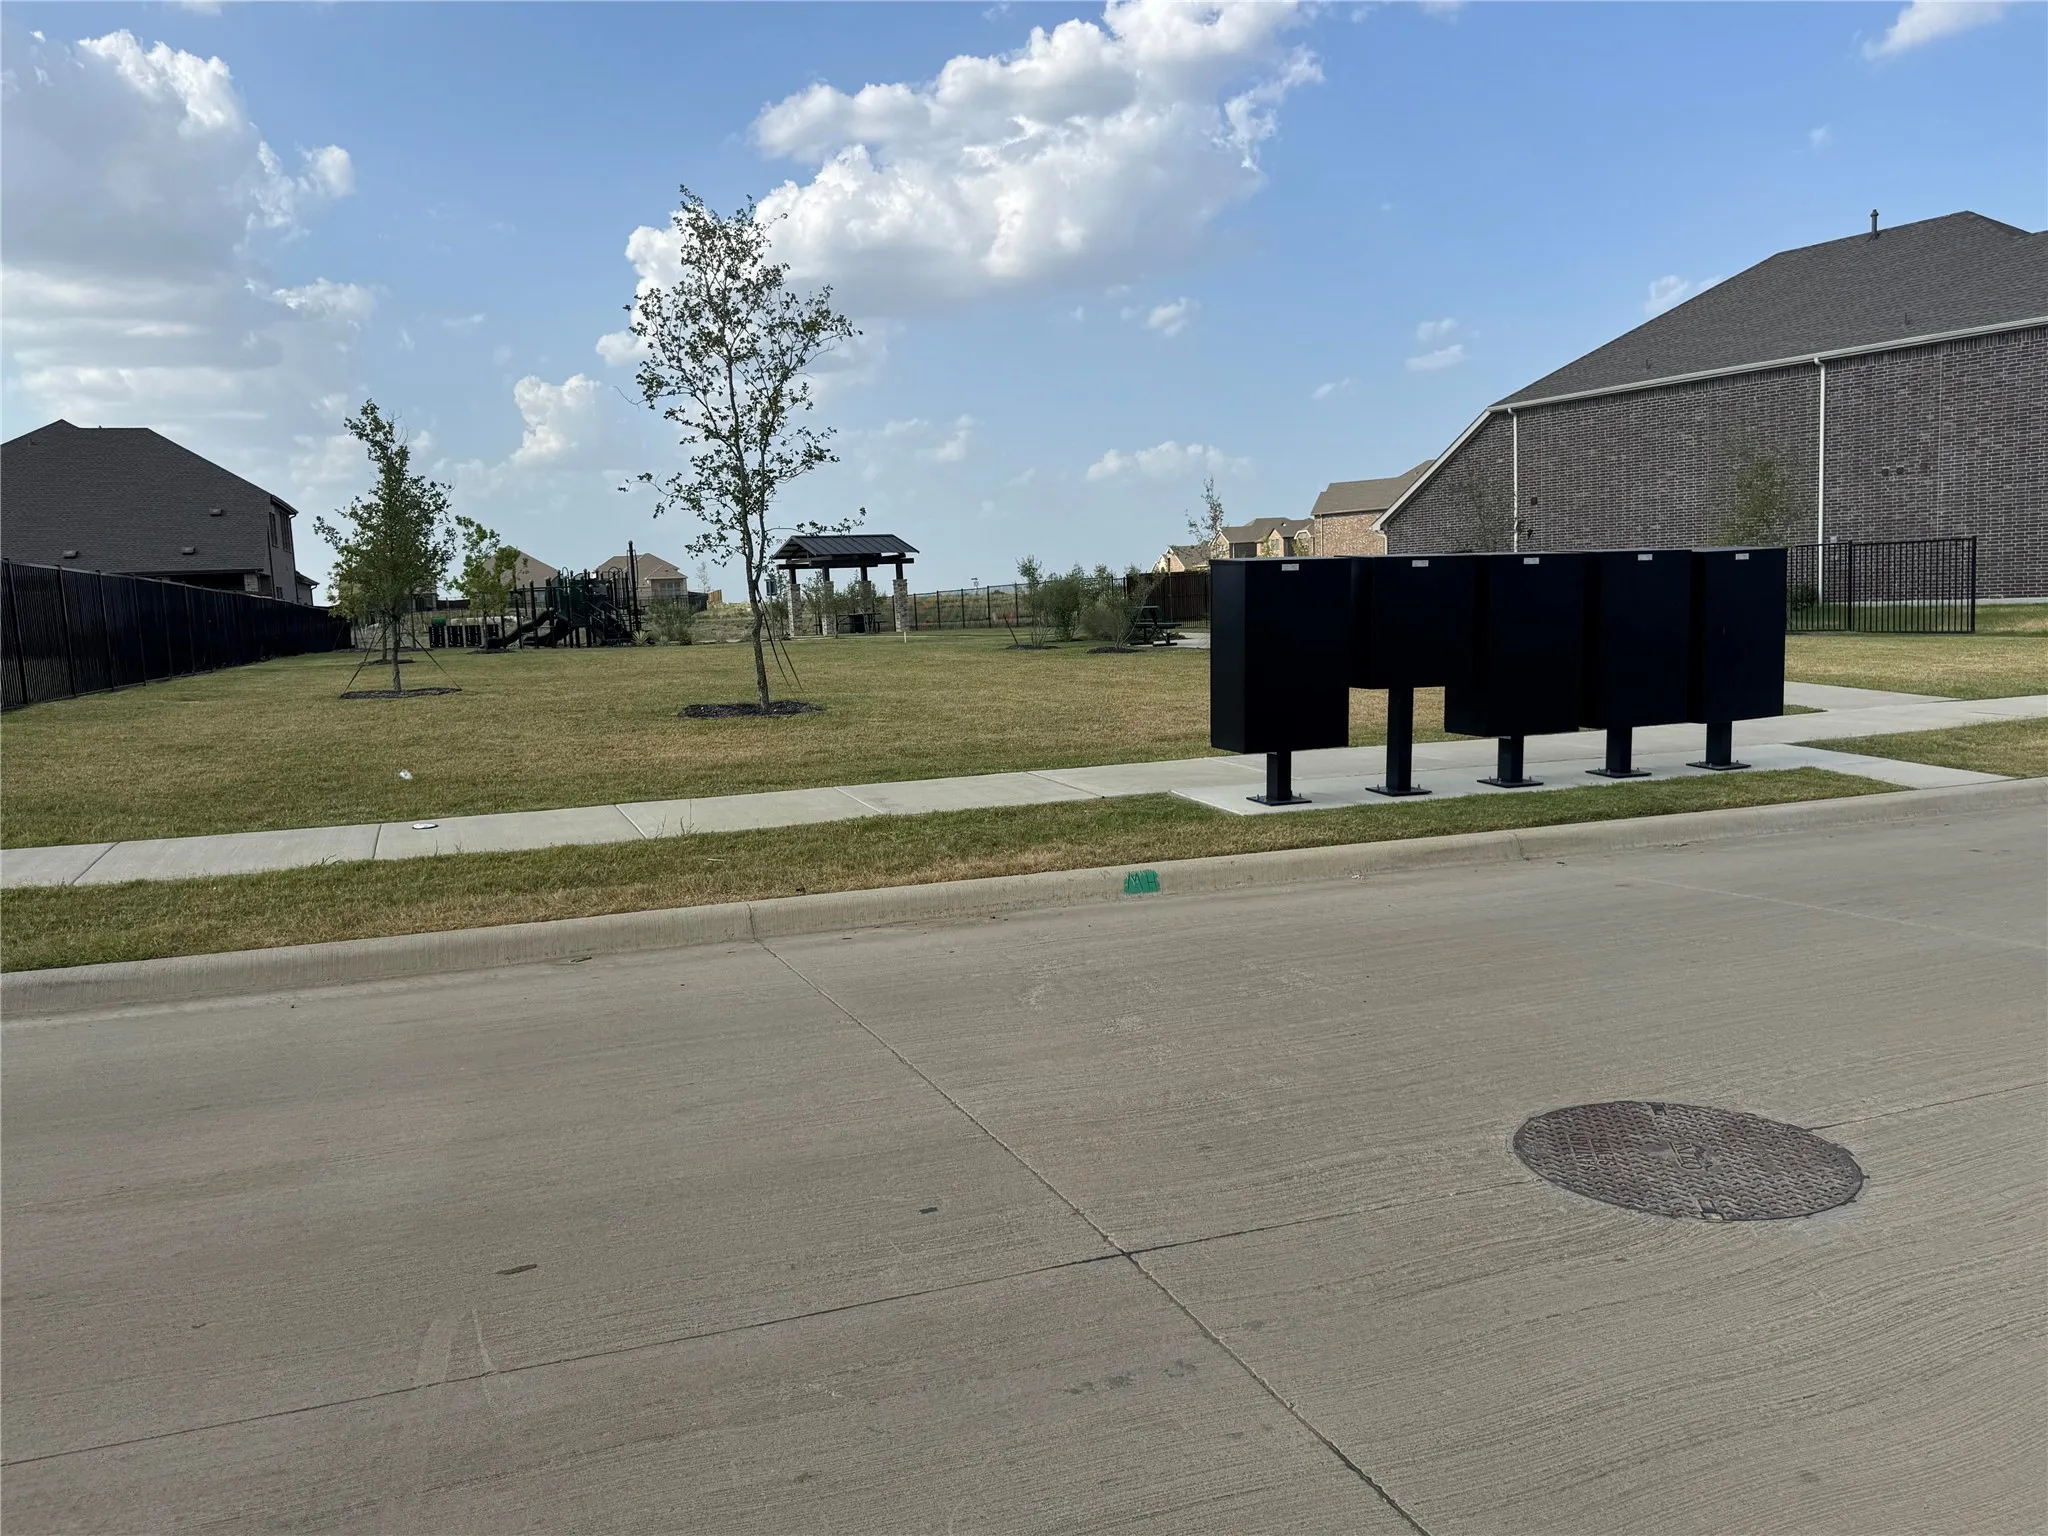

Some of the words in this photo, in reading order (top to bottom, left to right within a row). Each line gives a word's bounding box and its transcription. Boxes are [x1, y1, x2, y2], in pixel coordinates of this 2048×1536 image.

[1127, 871, 1158, 891] MH
[1568, 1132, 1597, 1171] SANITARY
[1591, 1138, 1617, 1166] SEWER
